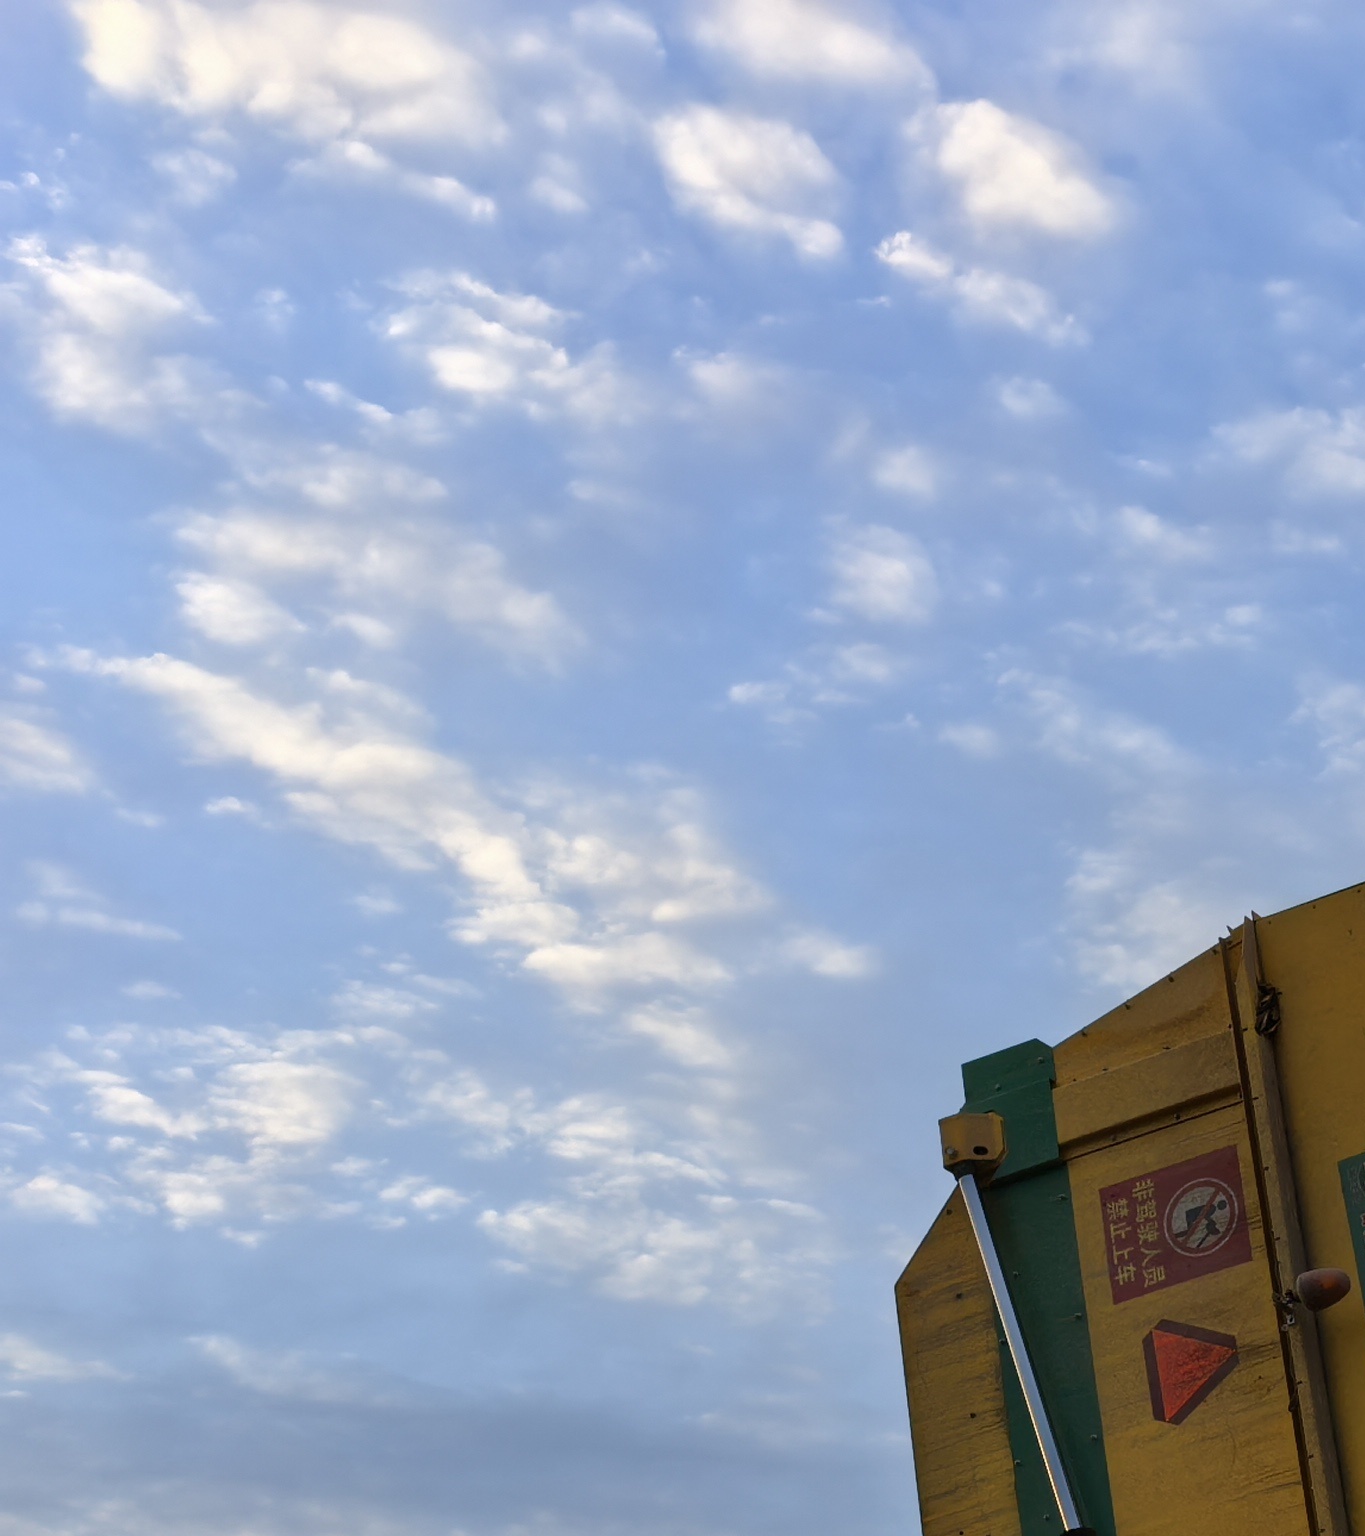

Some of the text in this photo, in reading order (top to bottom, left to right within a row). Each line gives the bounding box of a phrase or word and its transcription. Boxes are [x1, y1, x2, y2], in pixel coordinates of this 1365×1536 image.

[1105, 1197, 1131, 1286] 禁止上车
[1133, 1177, 1165, 1288] 非驾驶人员
